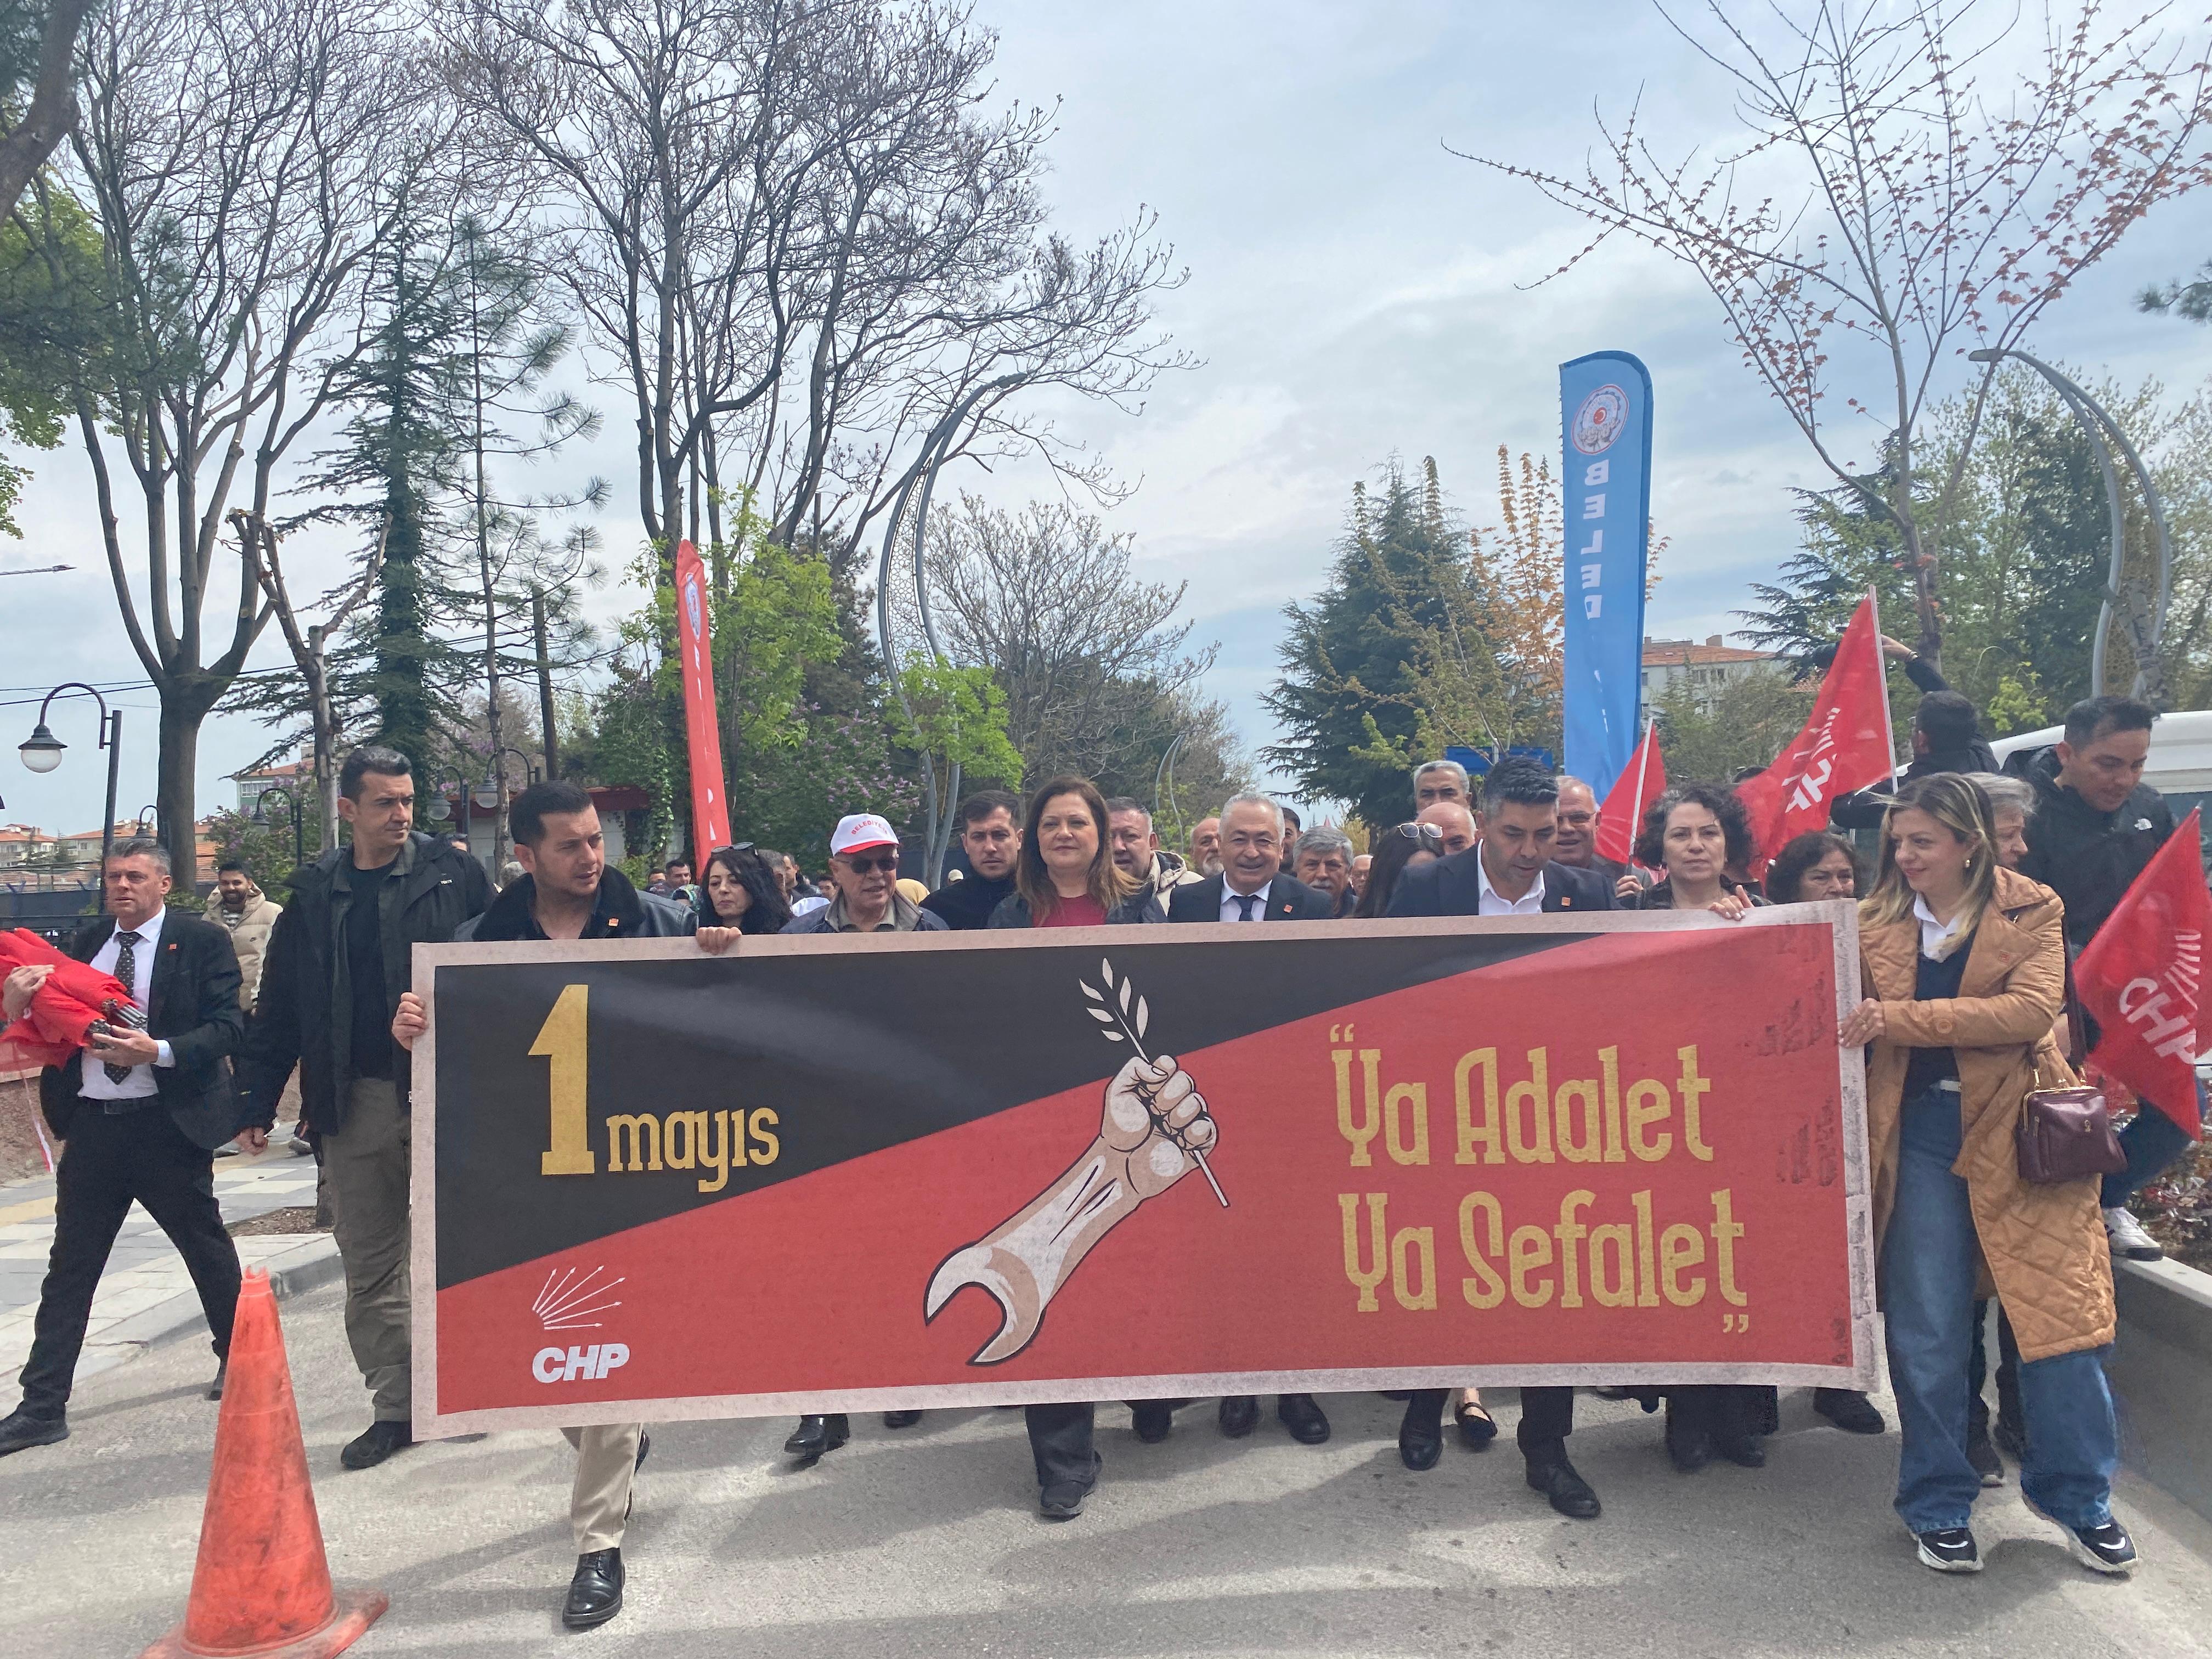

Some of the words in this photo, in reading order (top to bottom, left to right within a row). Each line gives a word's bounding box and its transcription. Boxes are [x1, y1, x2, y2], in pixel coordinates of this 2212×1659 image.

[2119, 977, 2197, 1065] CHP
[527, 984, 595, 1176] 1
[606, 1107, 780, 1193] mayıs
[1454, 1043, 1714, 1165] Adalet
[1338, 1192, 1438, 1313] Ya
[532, 1342, 630, 1384] CHP
